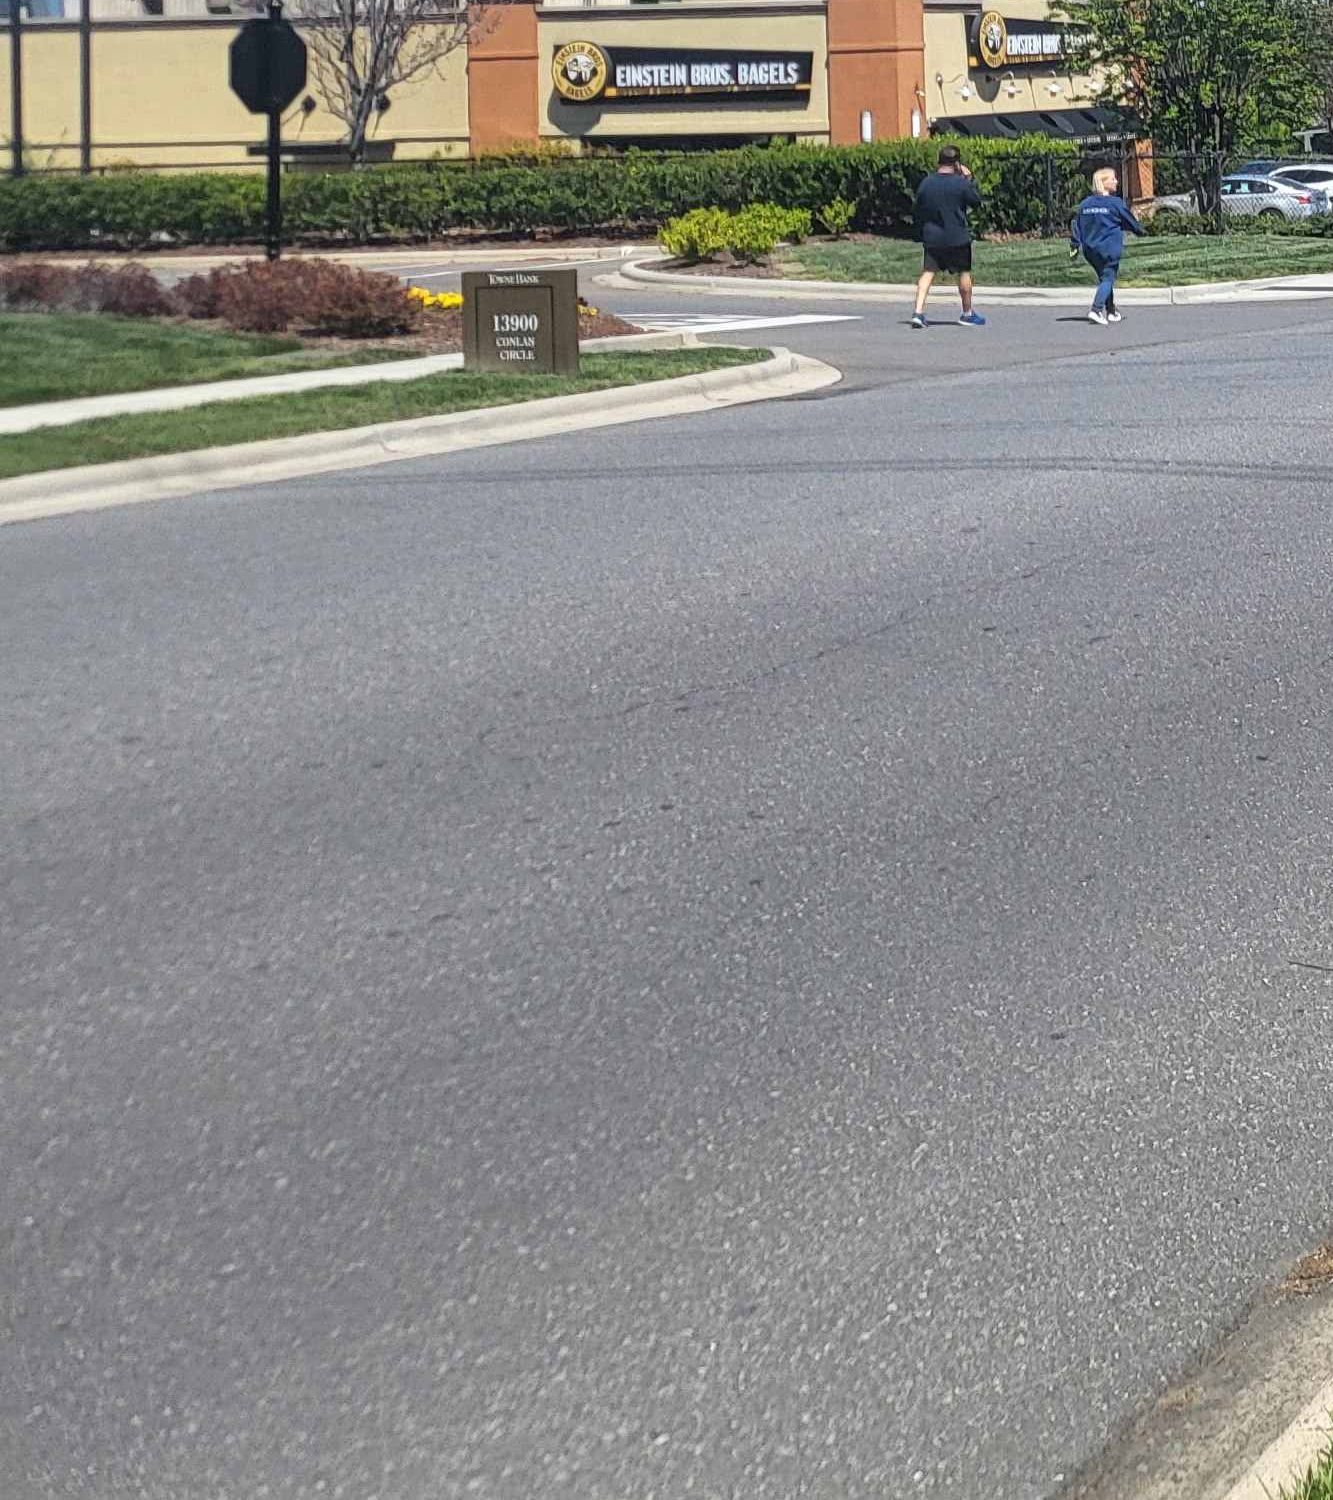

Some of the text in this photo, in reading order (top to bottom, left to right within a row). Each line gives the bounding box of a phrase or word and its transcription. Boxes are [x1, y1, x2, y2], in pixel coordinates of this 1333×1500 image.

[1006, 33, 1042, 56] EINSTEIN
[616, 61, 800, 88] EINSTEIN BROS. BAGELS
[493, 313, 539, 332] 13900
[496, 337, 535, 347] CONLAN
[500, 350, 535, 360] CIRCLE
